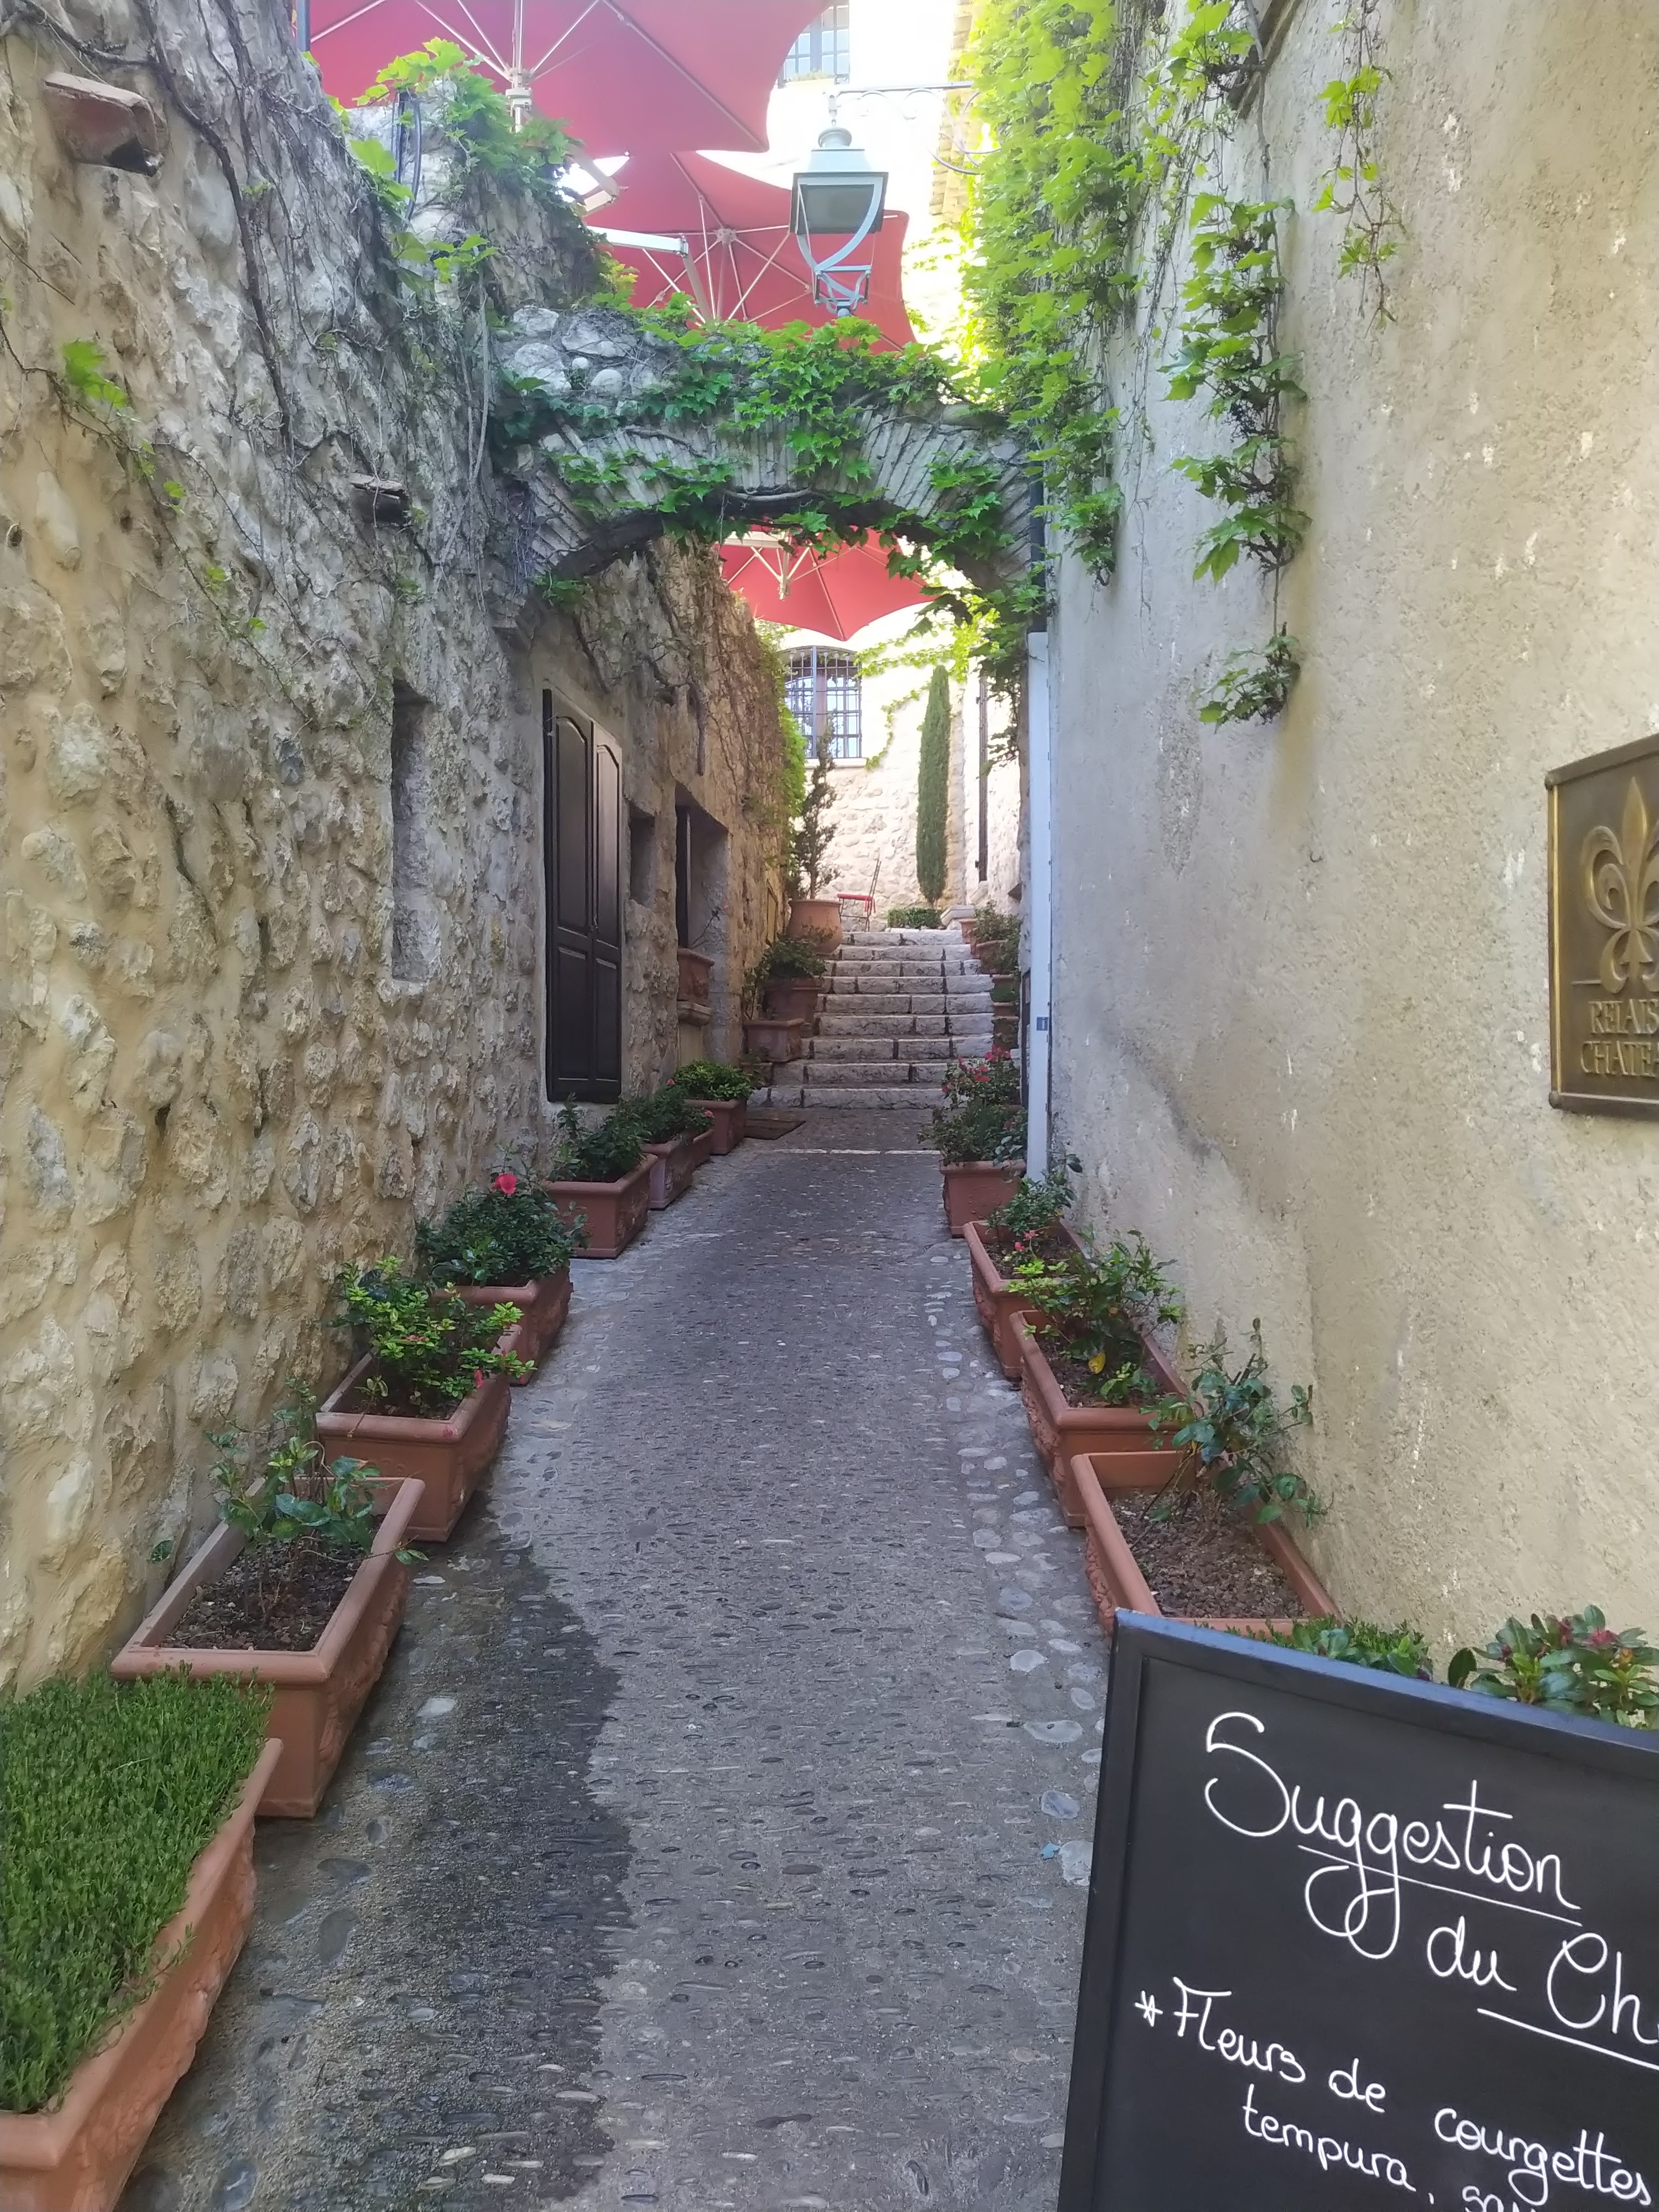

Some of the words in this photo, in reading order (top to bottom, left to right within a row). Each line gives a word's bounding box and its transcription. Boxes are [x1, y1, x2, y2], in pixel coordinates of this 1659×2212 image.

[1588, 999, 1658, 1034] RELAIS
[1204, 1712, 1582, 1959] Suggestion
[1427, 1916, 1517, 1991] du
[1547, 1933, 1659, 2044] Ch
[1173, 1976, 1306, 2083] Fleurs
[1328, 2058, 1385, 2112] de
[1434, 2108, 1651, 2205] courgettes
